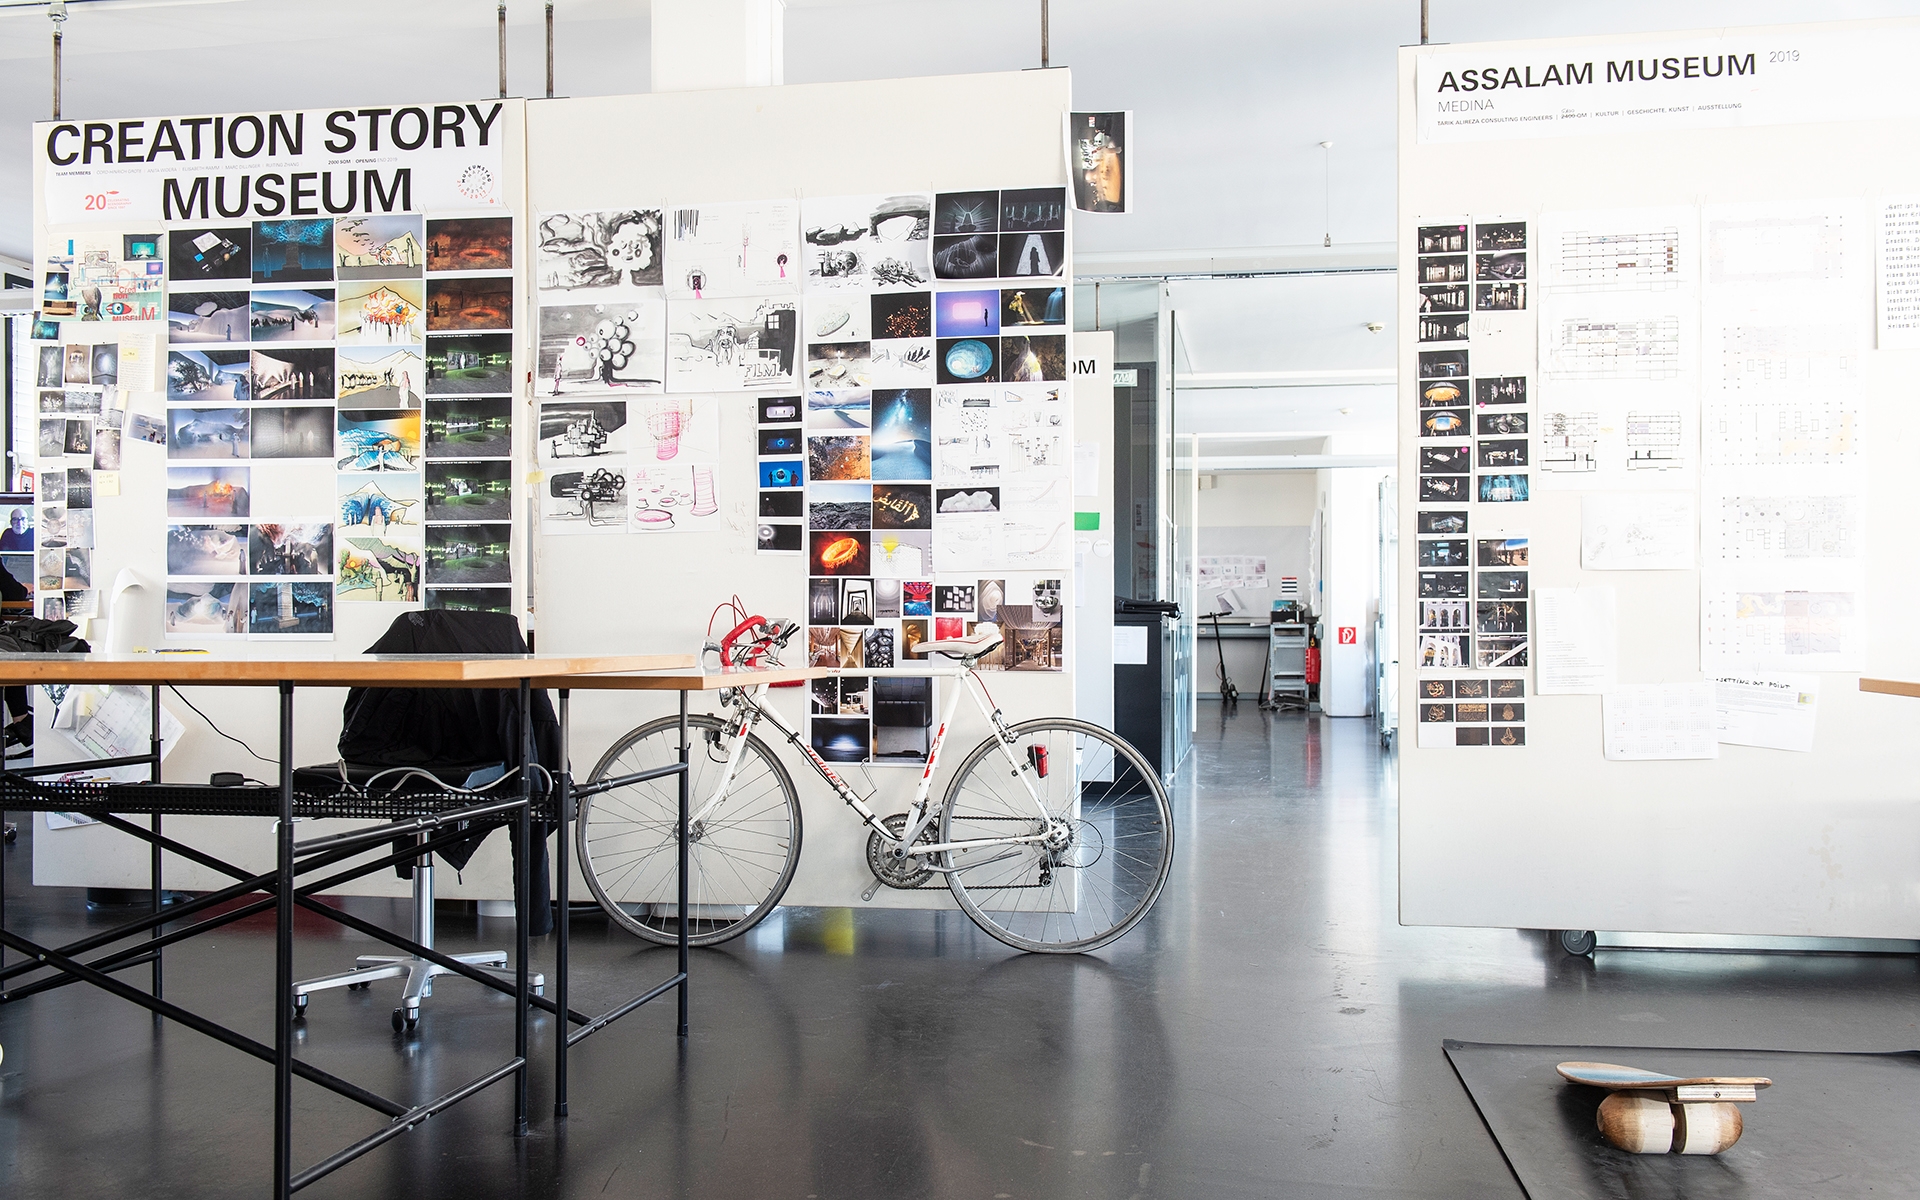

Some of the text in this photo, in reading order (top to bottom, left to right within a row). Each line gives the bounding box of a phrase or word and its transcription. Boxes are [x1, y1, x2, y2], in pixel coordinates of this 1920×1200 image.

[1437, 49, 1800, 93] ASSALAM MUSEUM 2019
[1438, 99, 1495, 113] MEDINA
[1519, 114, 1553, 122] ENGINEERS
[1626, 108, 1668, 116] GESCHICHTE,
[1697, 103, 1743, 111] AUSSTELLUNG
[47, 103, 503, 167] CREATION STORY
[461, 164, 492, 183] MUSEUMSTAG
[85, 194, 107, 210] 20
[162, 168, 412, 220] MUSEUM
[1768, 680, 1791, 690] POINT
